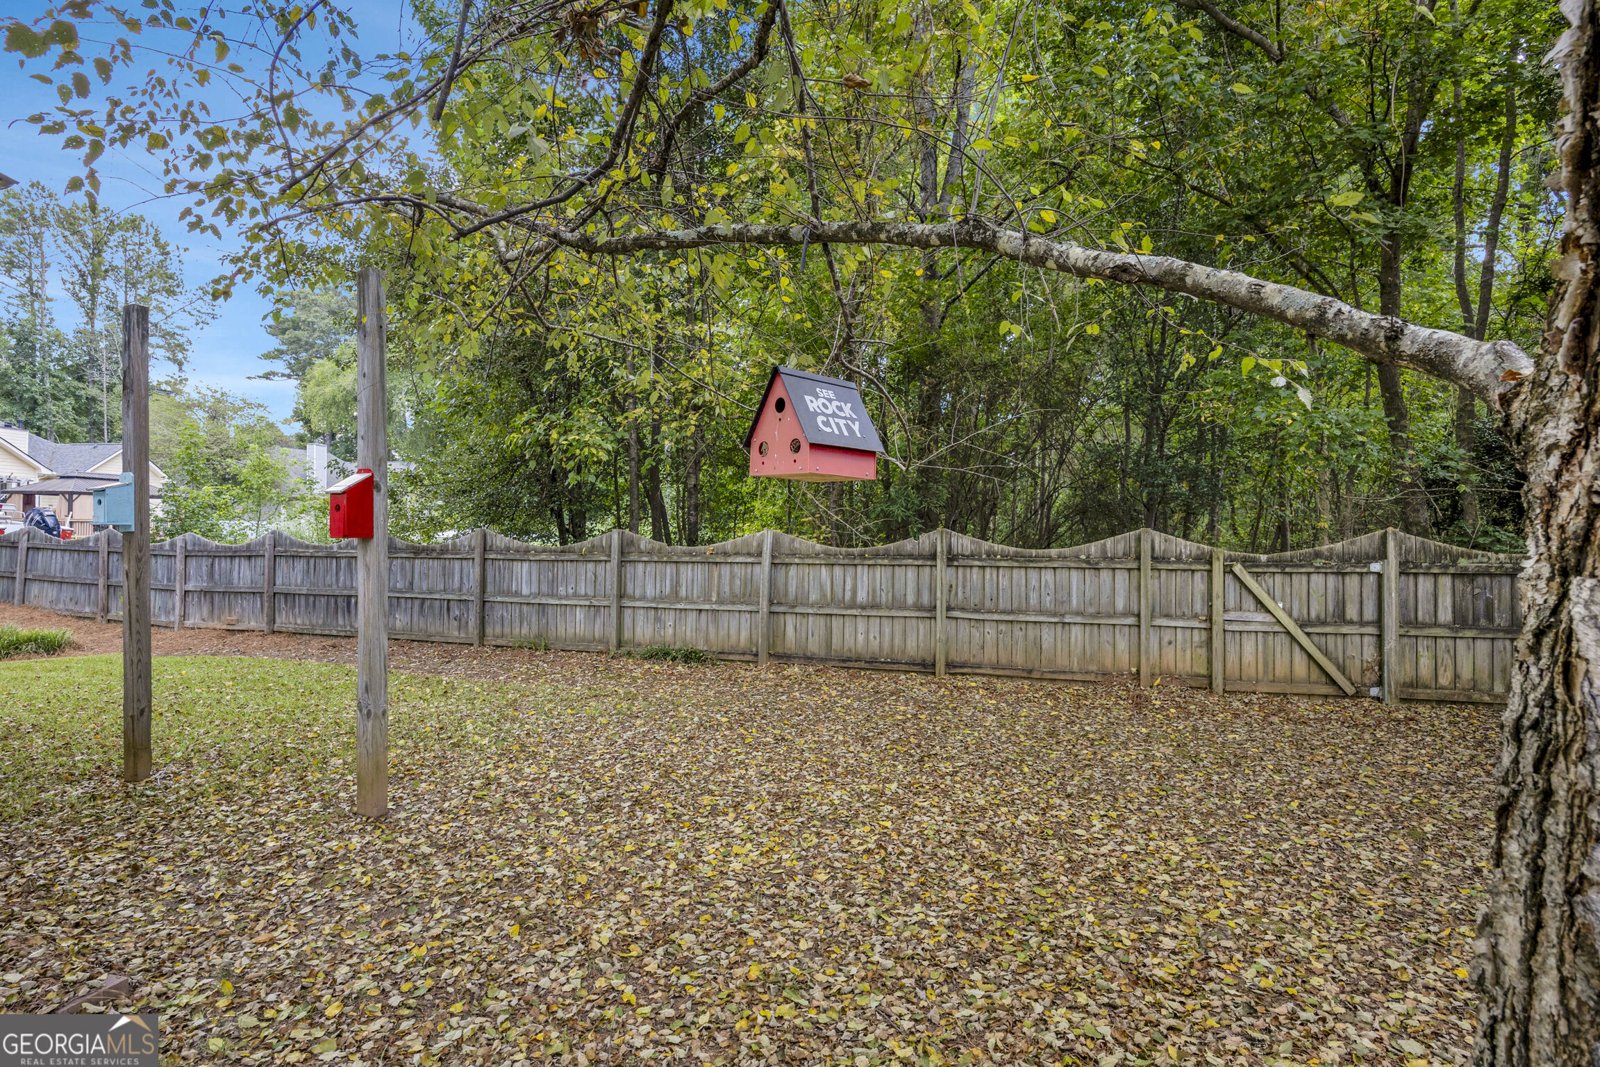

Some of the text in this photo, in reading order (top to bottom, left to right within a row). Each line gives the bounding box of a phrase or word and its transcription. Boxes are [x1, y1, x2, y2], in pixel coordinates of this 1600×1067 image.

[816, 387, 836, 400] SEE
[804, 394, 858, 419] ROCK
[816, 415, 861, 438] CITY
